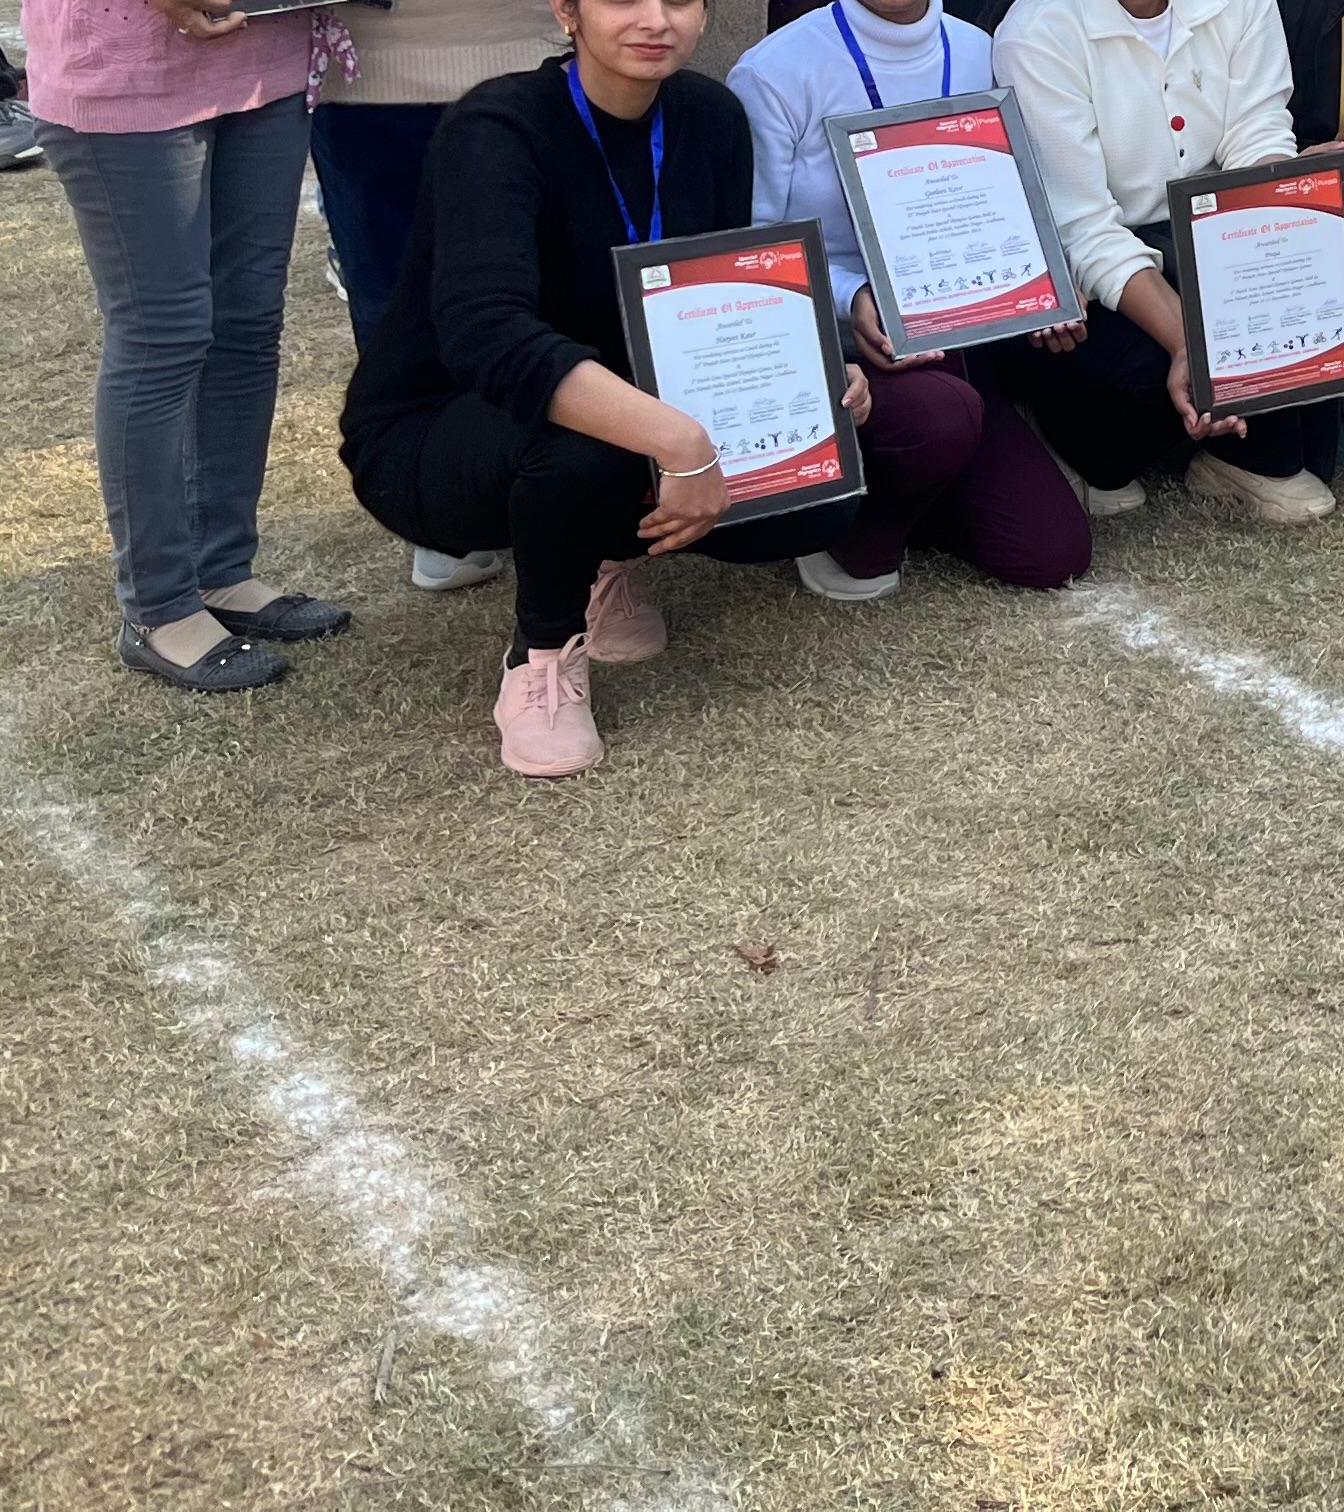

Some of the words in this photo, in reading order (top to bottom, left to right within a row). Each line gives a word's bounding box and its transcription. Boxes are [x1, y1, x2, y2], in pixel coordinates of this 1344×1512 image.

[888, 166, 924, 177] Certificate
[928, 162, 937, 170] Of
[1222, 229, 1257, 240] Certificate
[1261, 225, 1271, 233] Of
[678, 308, 717, 320] Certificate
[721, 303, 732, 313] Of
